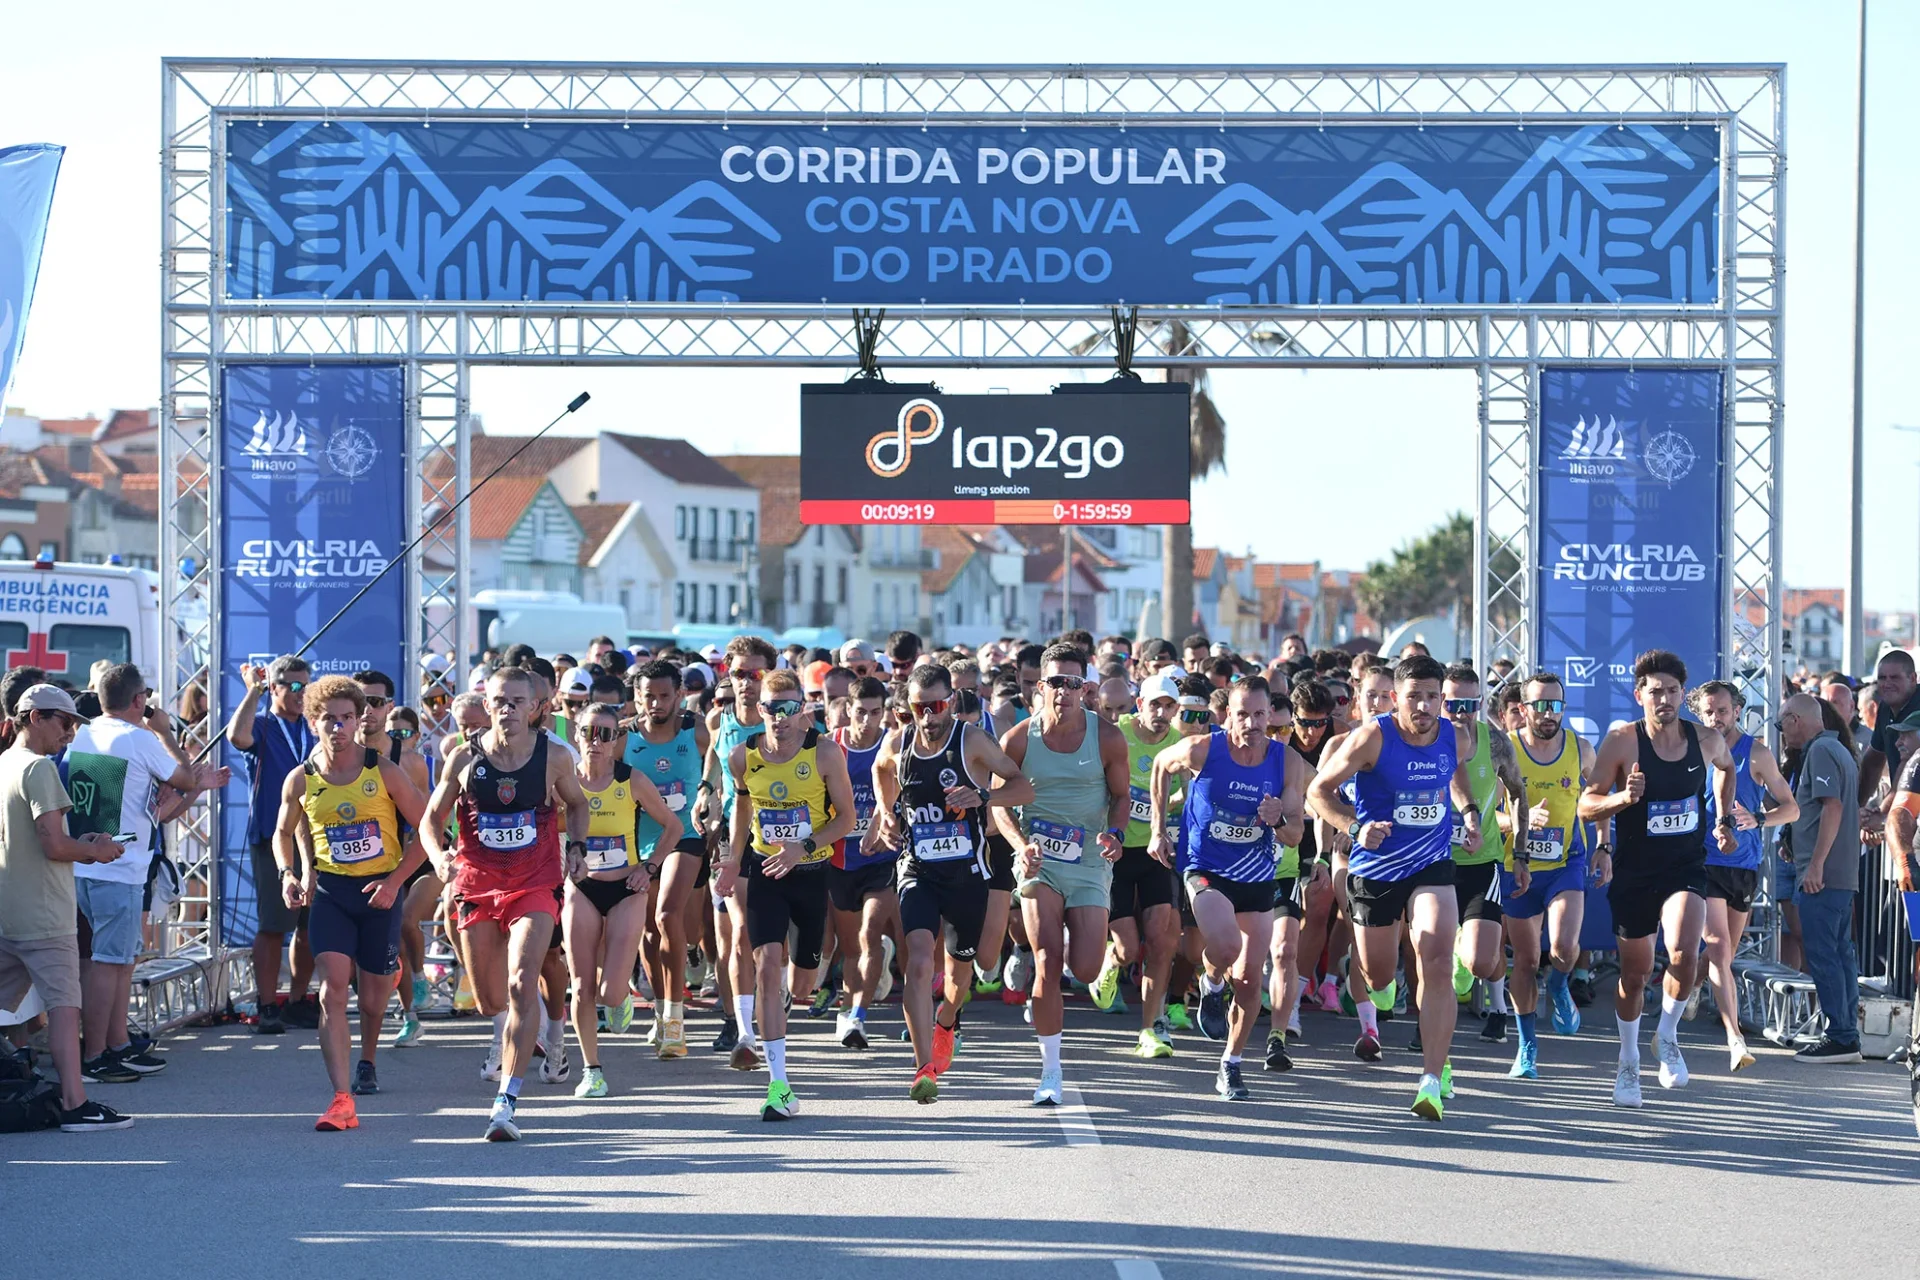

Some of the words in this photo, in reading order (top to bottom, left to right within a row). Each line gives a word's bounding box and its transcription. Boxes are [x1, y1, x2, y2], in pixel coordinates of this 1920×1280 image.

[720, 145, 961, 185] CORRIDA
[977, 147, 1227, 186] POPULAR
[805, 196, 977, 234] COSTA
[993, 196, 1141, 235] NOVA
[833, 246, 910, 283] DO
[928, 246, 1113, 284] PRADO
[952, 426, 1125, 480] lap2go
[954, 485, 988, 496] timing
[989, 485, 1031, 495] solution
[861, 504, 935, 520] 00:09:19
[1053, 504, 1132, 520] 0-1:59:59
[243, 540, 382, 557] CIVILRIA
[1560, 543, 1700, 562] CIVILRIA
[236, 559, 389, 577] RUNCLUB
[1553, 563, 1706, 581] RUNCLUB
[0, 579, 110, 599] BULÂNCIA
[274, 581, 292, 589] FOR
[309, 581, 350, 589] RUNNERS
[0, 597, 109, 616] ERGÊNCIA
[312, 658, 370, 671] CRÉDITO
[1608, 664, 1626, 675] TD
[1398, 811, 1406, 819] D
[1411, 806, 1438, 819] 393
[1652, 821, 1659, 829] A
[1663, 814, 1690, 828] 917
[483, 834, 492, 842] A
[495, 828, 525, 843] 318
[764, 830, 771, 838] D
[774, 824, 800, 838] 827
[1214, 826, 1221, 834] D
[1225, 827, 1253, 838] 396
[333, 847, 340, 855] D
[342, 839, 371, 855] 985
[920, 846, 928, 854] A
[932, 837, 959, 852] 441
[1043, 838, 1071, 854] 407
[1526, 840, 1553, 854] 438
